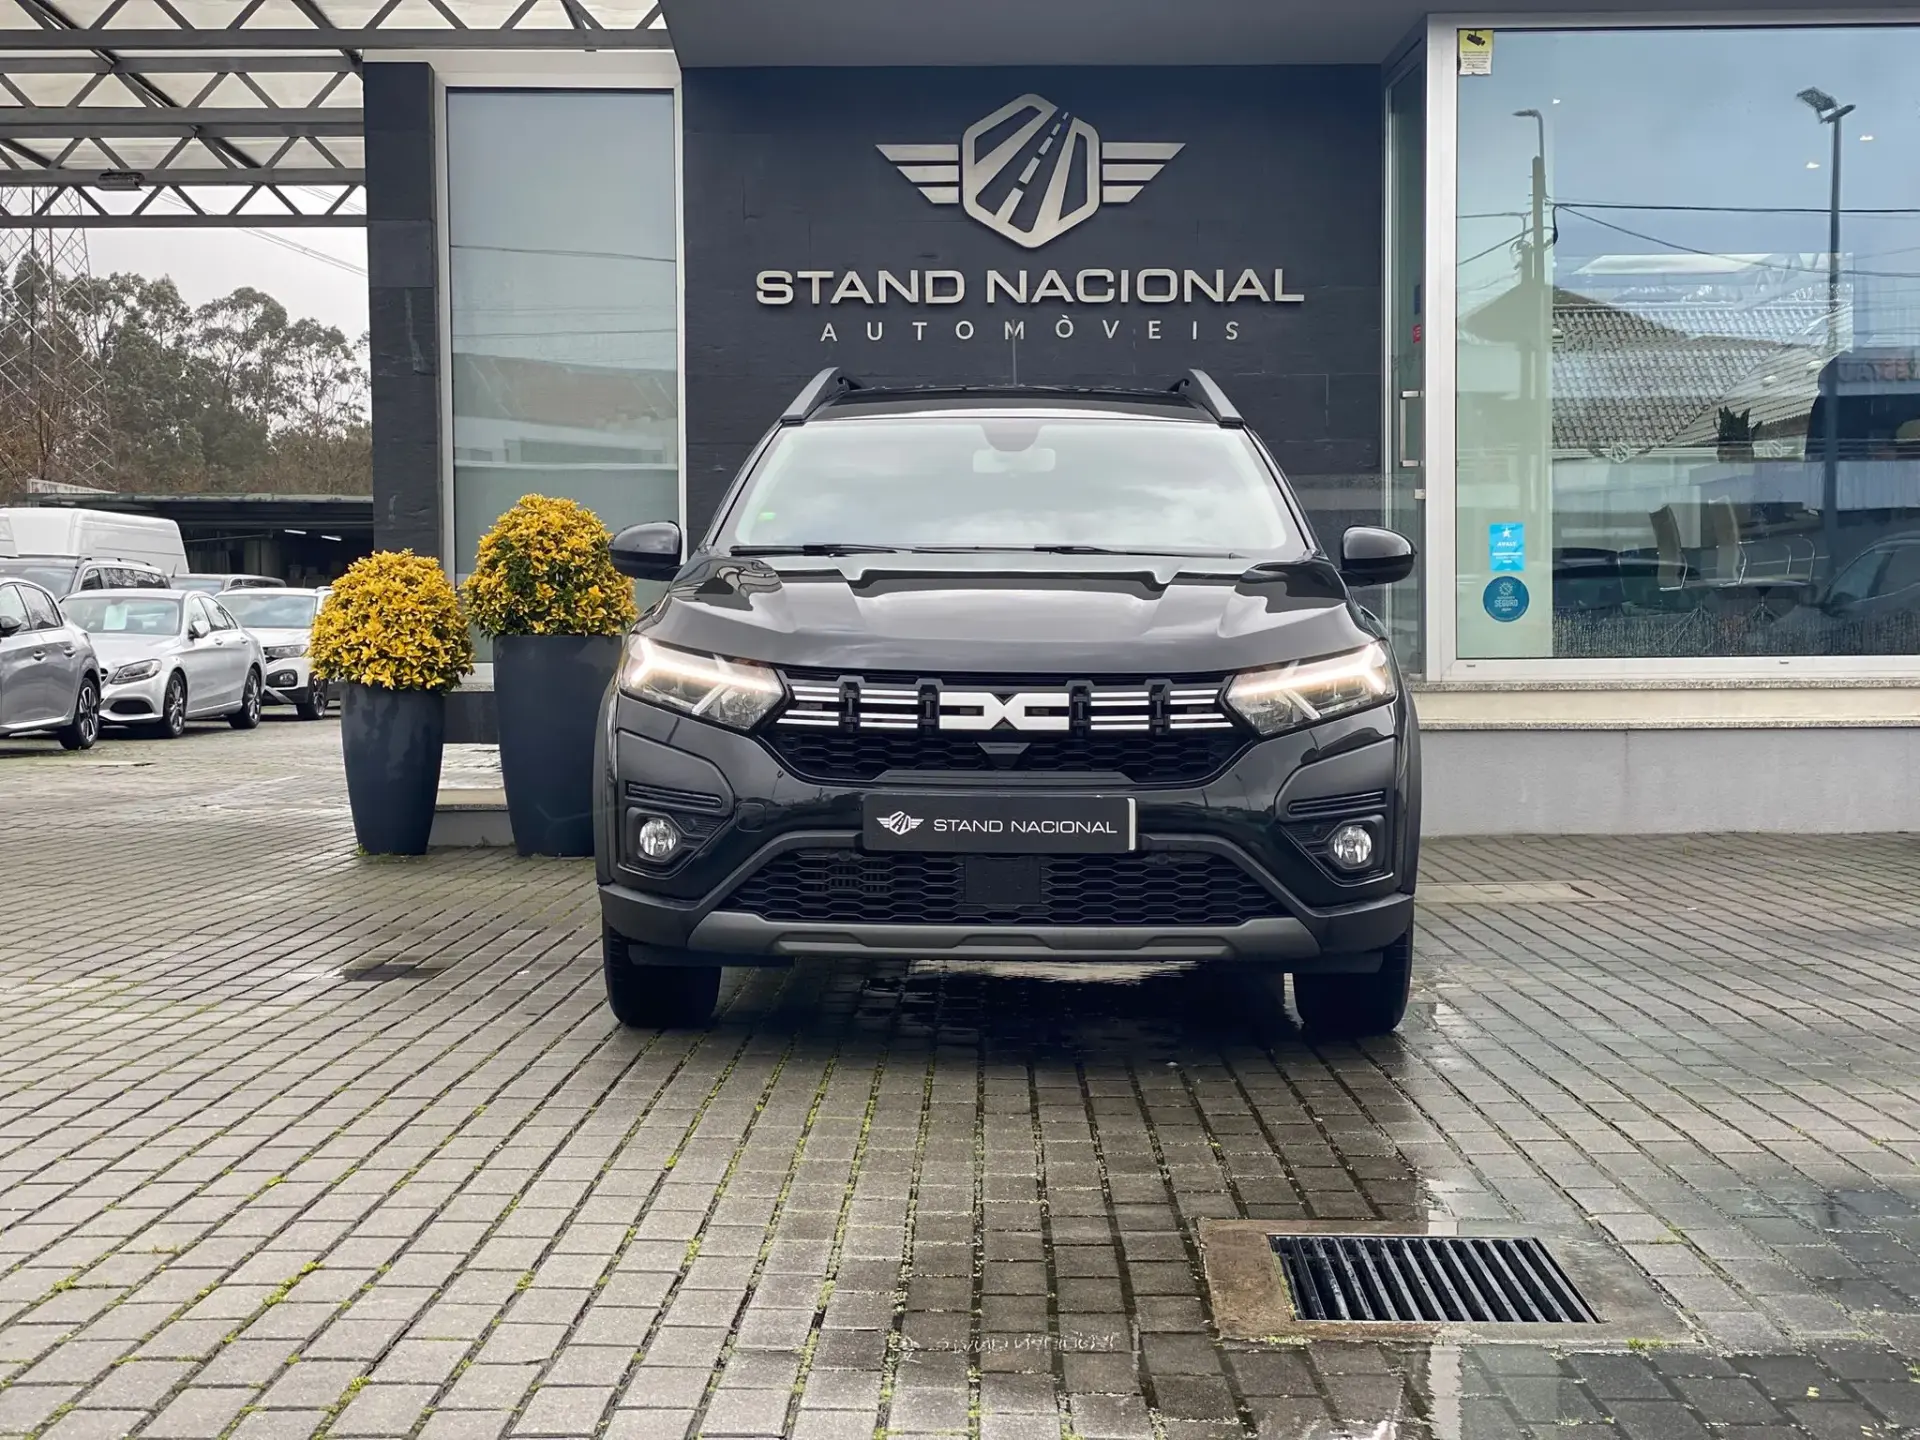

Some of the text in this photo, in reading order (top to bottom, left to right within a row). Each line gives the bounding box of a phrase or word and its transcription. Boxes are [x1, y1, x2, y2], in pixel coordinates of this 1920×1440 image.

[756, 268, 1305, 305] STAND NACIONAL
[933, 818, 1118, 835] STAND NACIONAL
